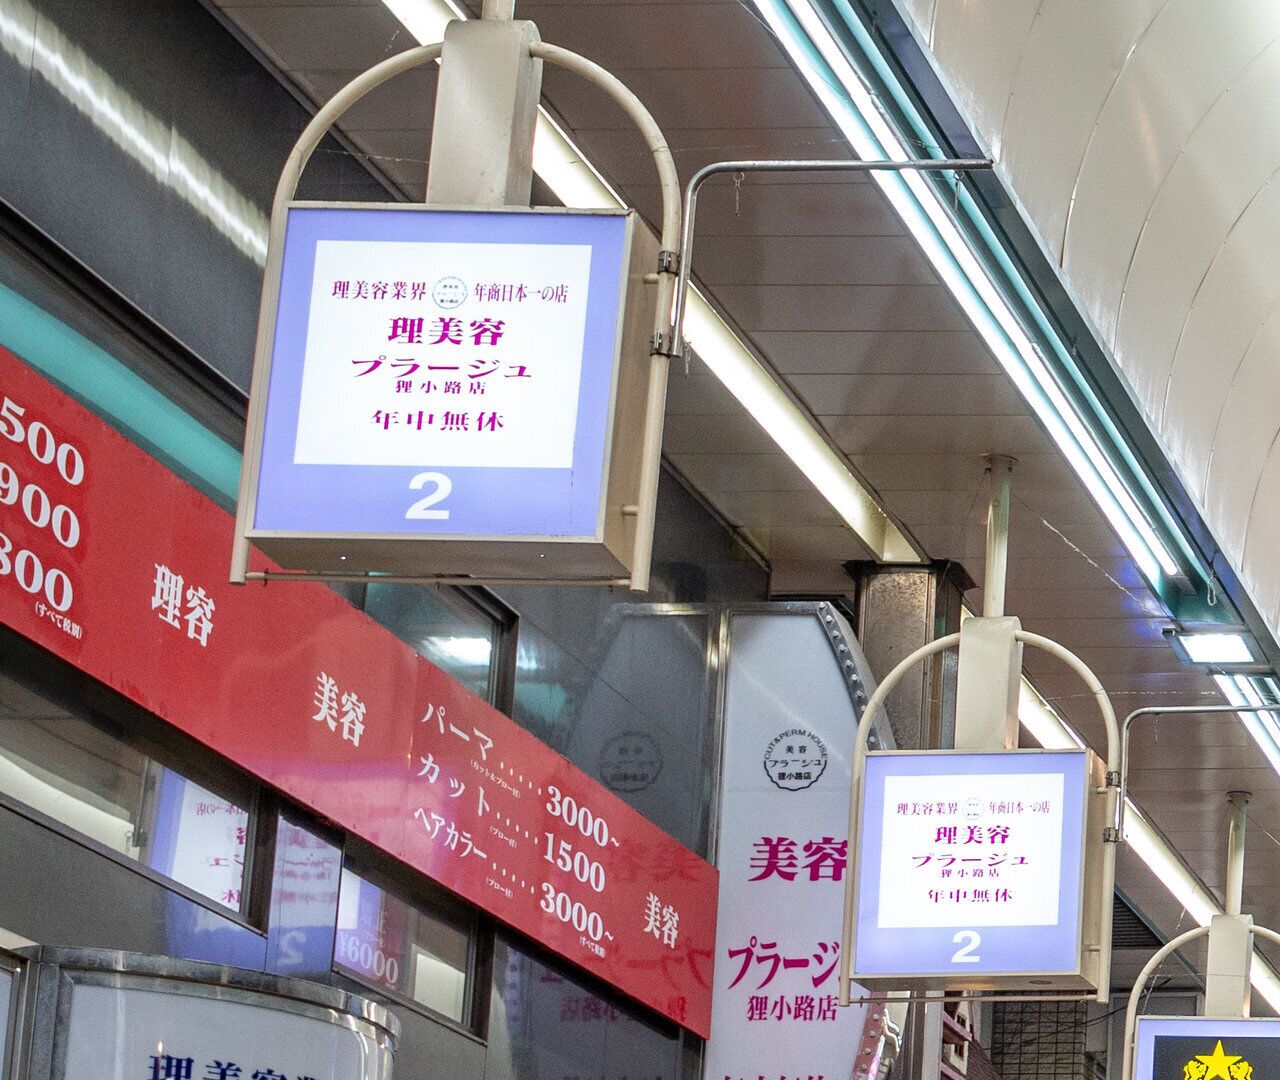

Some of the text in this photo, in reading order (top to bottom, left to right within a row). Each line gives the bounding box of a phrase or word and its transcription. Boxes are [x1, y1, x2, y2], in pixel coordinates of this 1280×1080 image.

[332, 280, 427, 301] 理美容業界
[475, 283, 569, 303] 年商日本一の店
[388, 317, 505, 346] 理美容
[351, 355, 532, 379] プラージュ
[395, 380, 487, 394] 狸小路店
[371, 410, 504, 432] 年中無休
[405, 471, 453, 519] 2
[152, 563, 215, 647] 理容
[312, 672, 367, 747] 美容
[421, 703, 494, 761] パーマ
[417, 753, 605, 892] カット 1500
[896, 801, 1050, 816] 理美容業界 年商日本一の店
[414, 808, 488, 859] ヘアカラー
[934, 825, 1010, 844] 理美容
[748, 836, 847, 882] 美容
[911, 853, 1029, 868] プラージュ
[941, 868, 999, 878] 狸小路店
[928, 888, 1013, 903] 年中無休
[644, 891, 679, 949] 美容
[951, 930, 981, 963] 2
[747, 994, 838, 1022] 狸小路店
